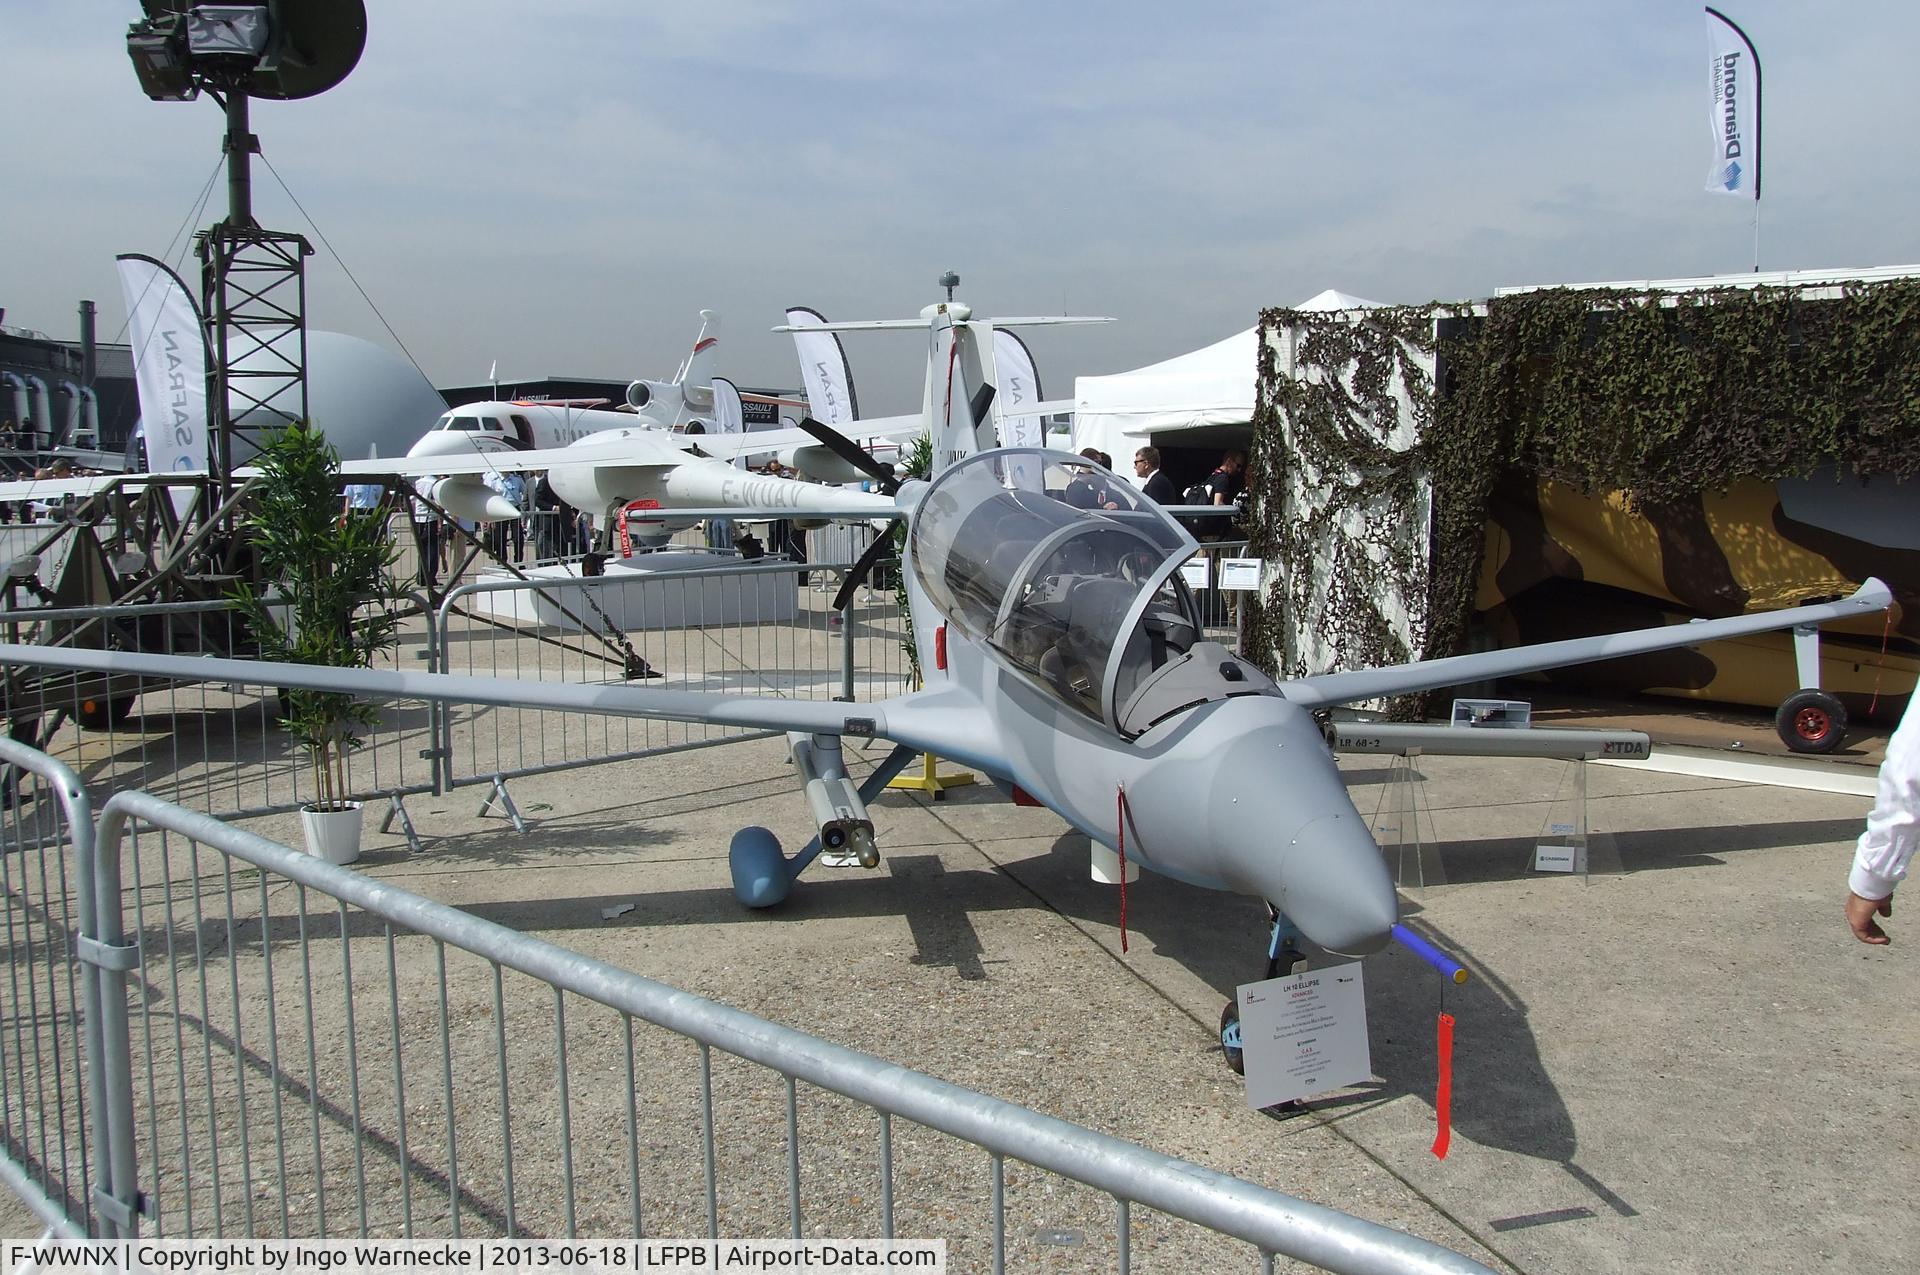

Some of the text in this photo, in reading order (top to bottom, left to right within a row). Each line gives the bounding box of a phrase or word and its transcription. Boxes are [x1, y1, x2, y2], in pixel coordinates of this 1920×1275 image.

[742, 403, 774, 412] SSAULT
[721, 480, 806, 508] F-WUAV
[1340, 738, 1380, 748] LR 68-2
[1614, 741, 1643, 754] TDA
